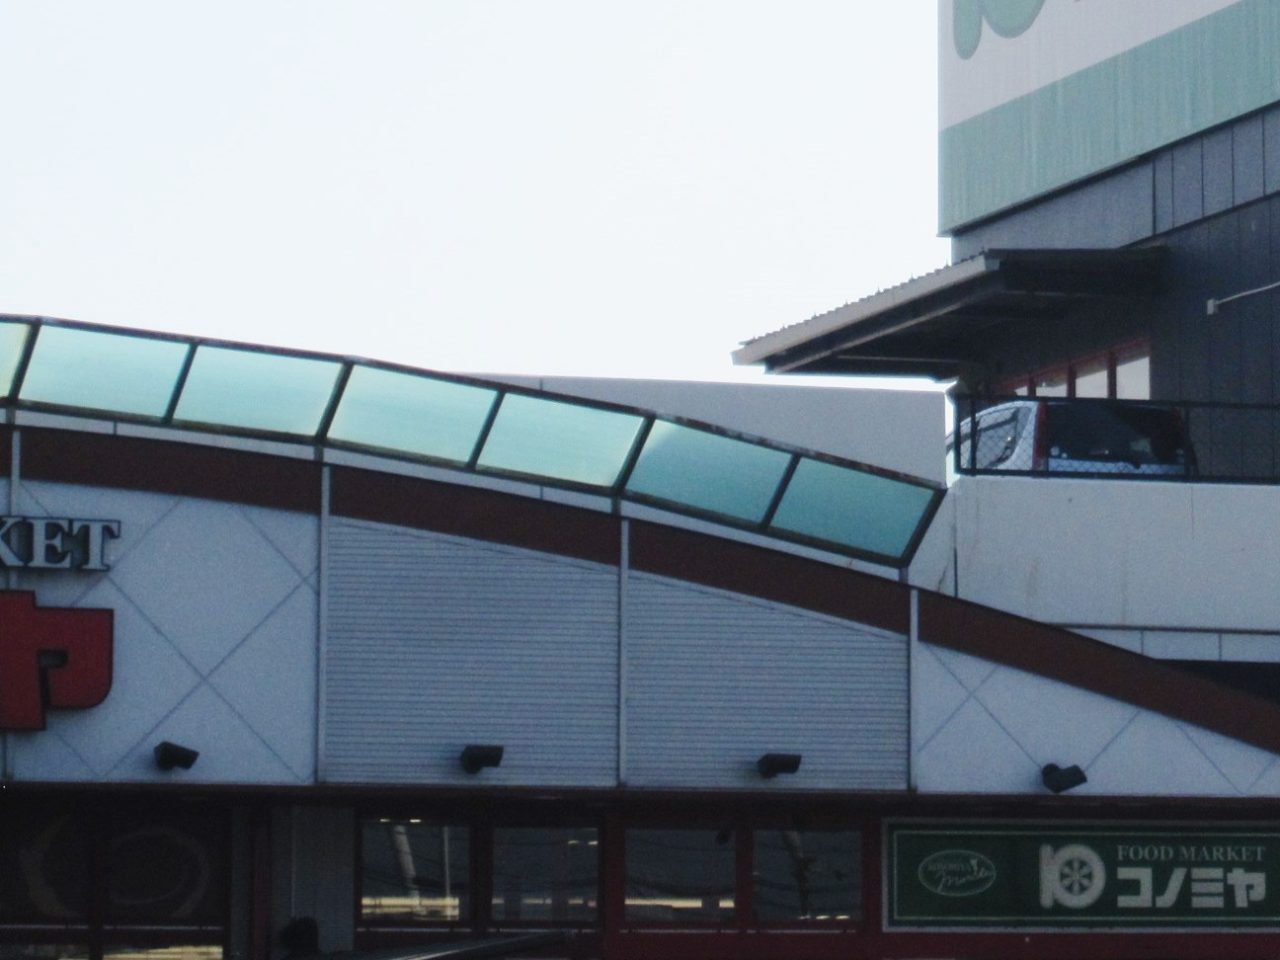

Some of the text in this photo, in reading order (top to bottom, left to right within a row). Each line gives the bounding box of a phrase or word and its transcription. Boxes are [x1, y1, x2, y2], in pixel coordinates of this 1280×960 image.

[1116, 844, 1266, 862] FOOD MARKET
[1116, 867, 1266, 909] コノミヤ
